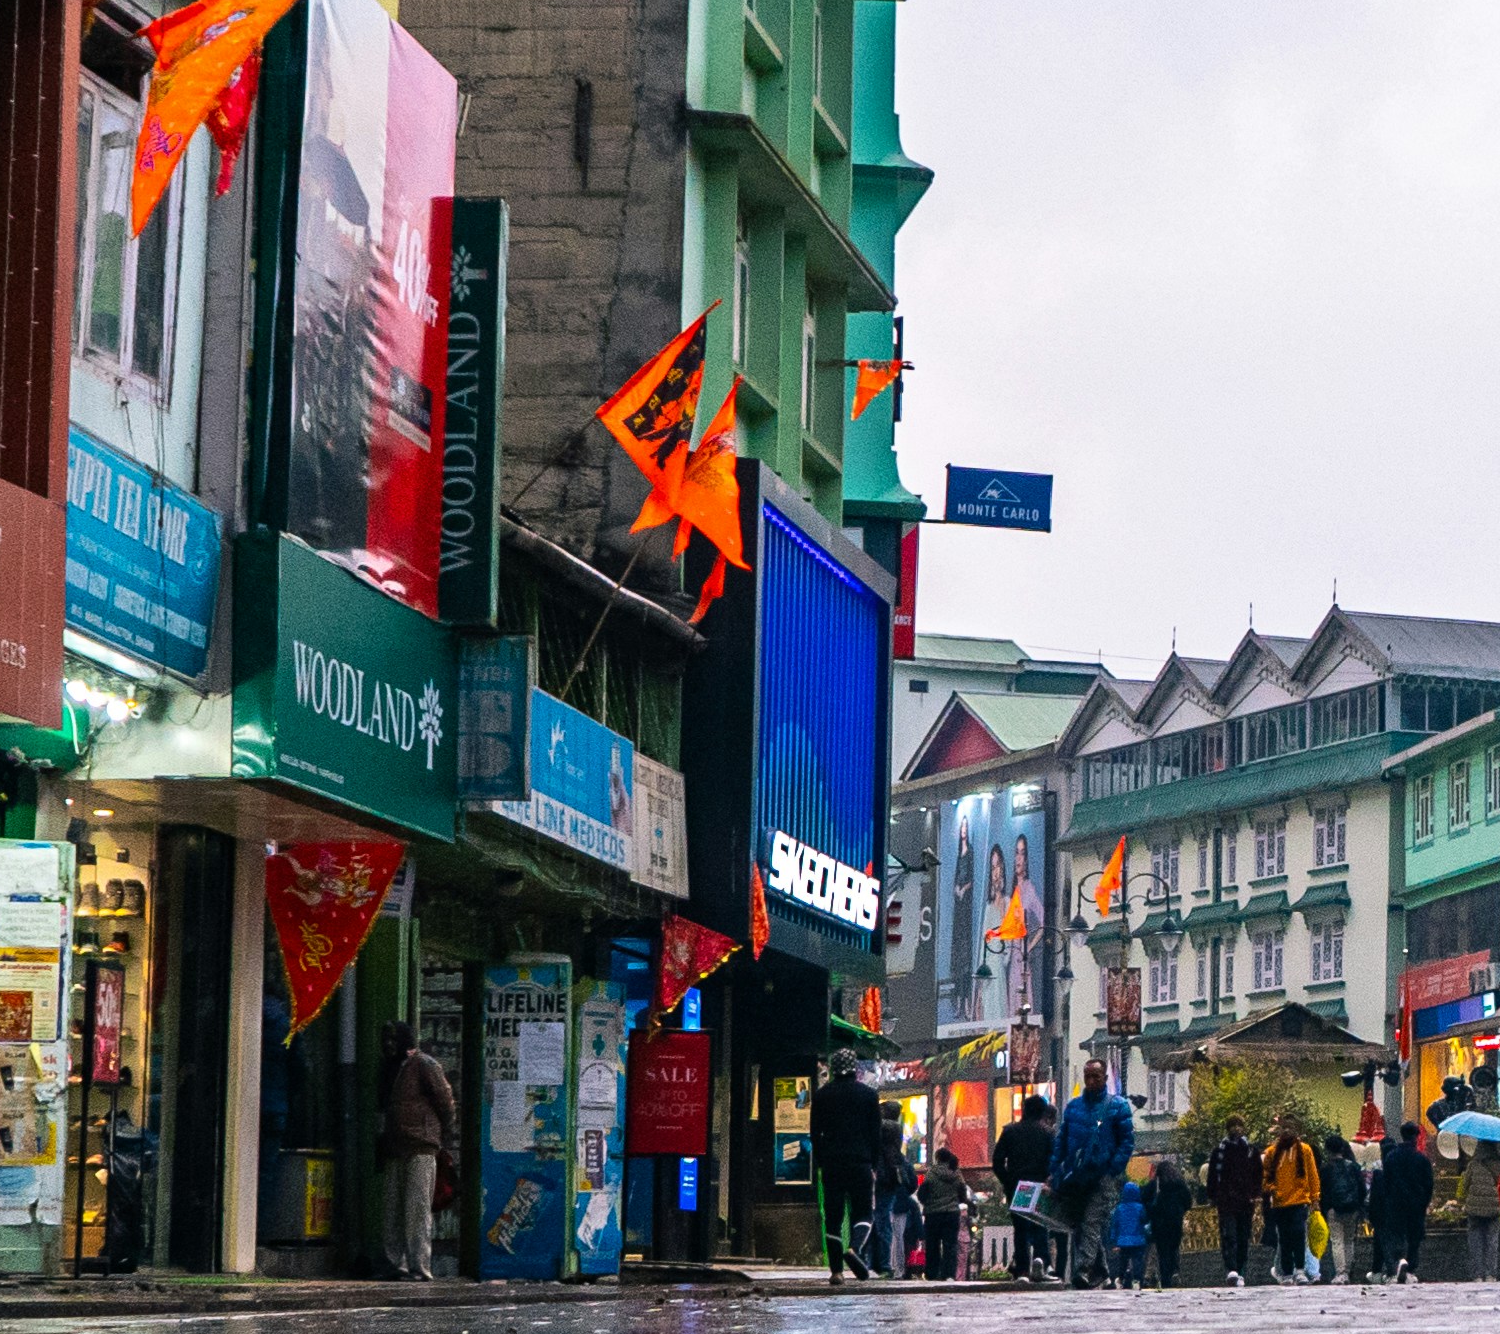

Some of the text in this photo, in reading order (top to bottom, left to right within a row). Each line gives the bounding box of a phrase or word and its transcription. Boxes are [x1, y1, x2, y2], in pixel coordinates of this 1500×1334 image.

[438, 311, 481, 574] WOODLAND
[114, 474, 143, 541] TEA
[957, 503, 1041, 523] MONTE CARLO
[293, 639, 416, 752] WOODLAND
[535, 796, 565, 835] LINE
[568, 817, 626, 864] MEDICOS
[768, 829, 881, 932] SKECHERS
[487, 990, 567, 1015] LIFELINE
[488, 1058, 519, 1070] GAN
[646, 1066, 698, 1083] SALE
